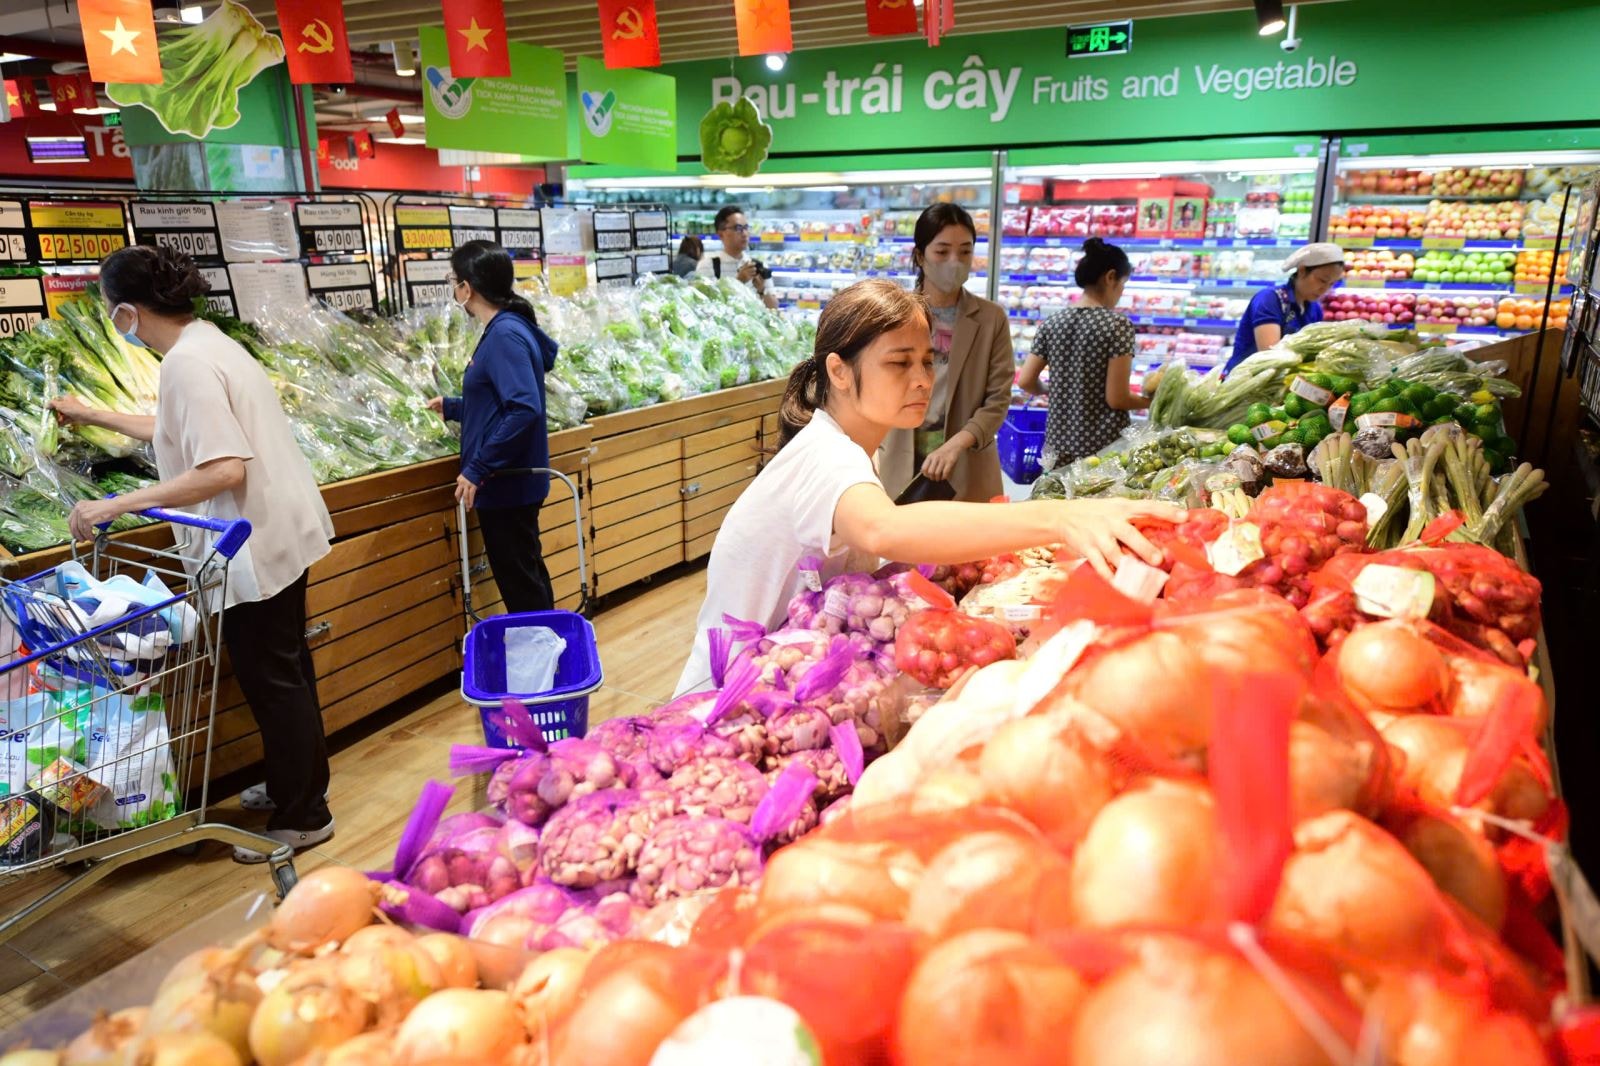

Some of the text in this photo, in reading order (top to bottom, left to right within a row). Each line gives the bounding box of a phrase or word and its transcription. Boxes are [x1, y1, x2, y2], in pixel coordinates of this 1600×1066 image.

[923, 55, 1022, 122] cây
[1033, 76, 1108, 104] Fruits
[1122, 67, 1179, 99] and
[1195, 55, 1357, 100] Vegetable
[43, 237, 110, 254] 22.500
